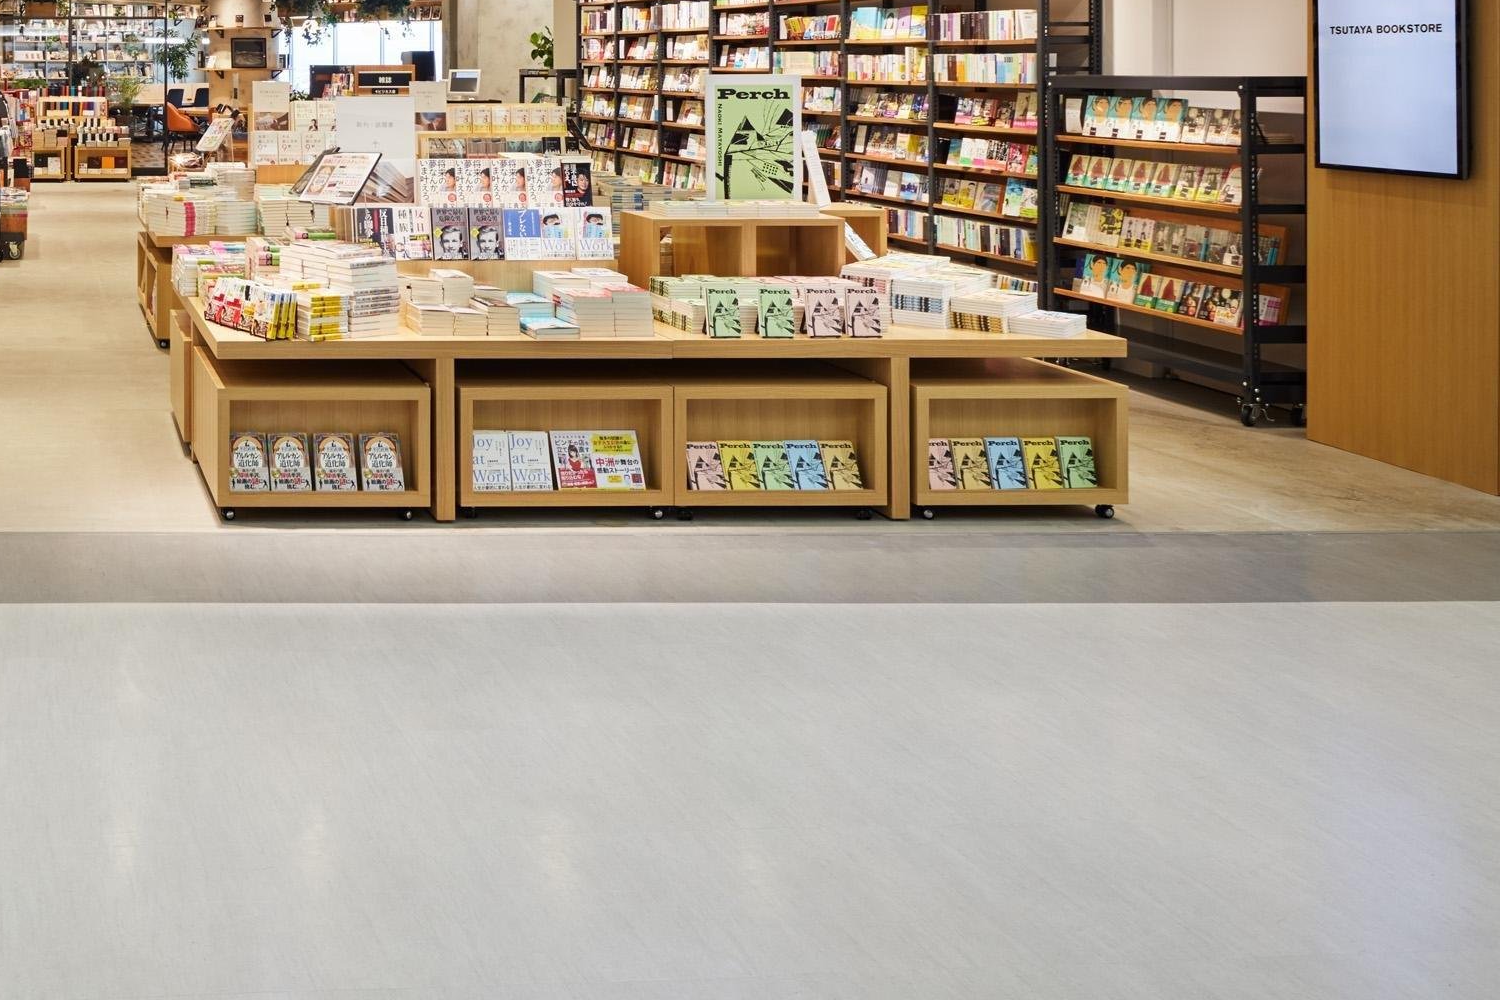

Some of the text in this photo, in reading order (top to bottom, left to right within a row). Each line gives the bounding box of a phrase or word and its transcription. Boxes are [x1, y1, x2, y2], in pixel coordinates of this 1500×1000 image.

[1329, 23, 1443, 35] TSUTAYA BOOKSTORE
[716, 88, 790, 100] Perch
[580, 239, 612, 251] Work
[511, 433, 533, 451] Joy
[473, 455, 485, 464] at
[512, 454, 525, 464] at
[473, 468, 510, 482] Work
[513, 468, 552, 482] Work
